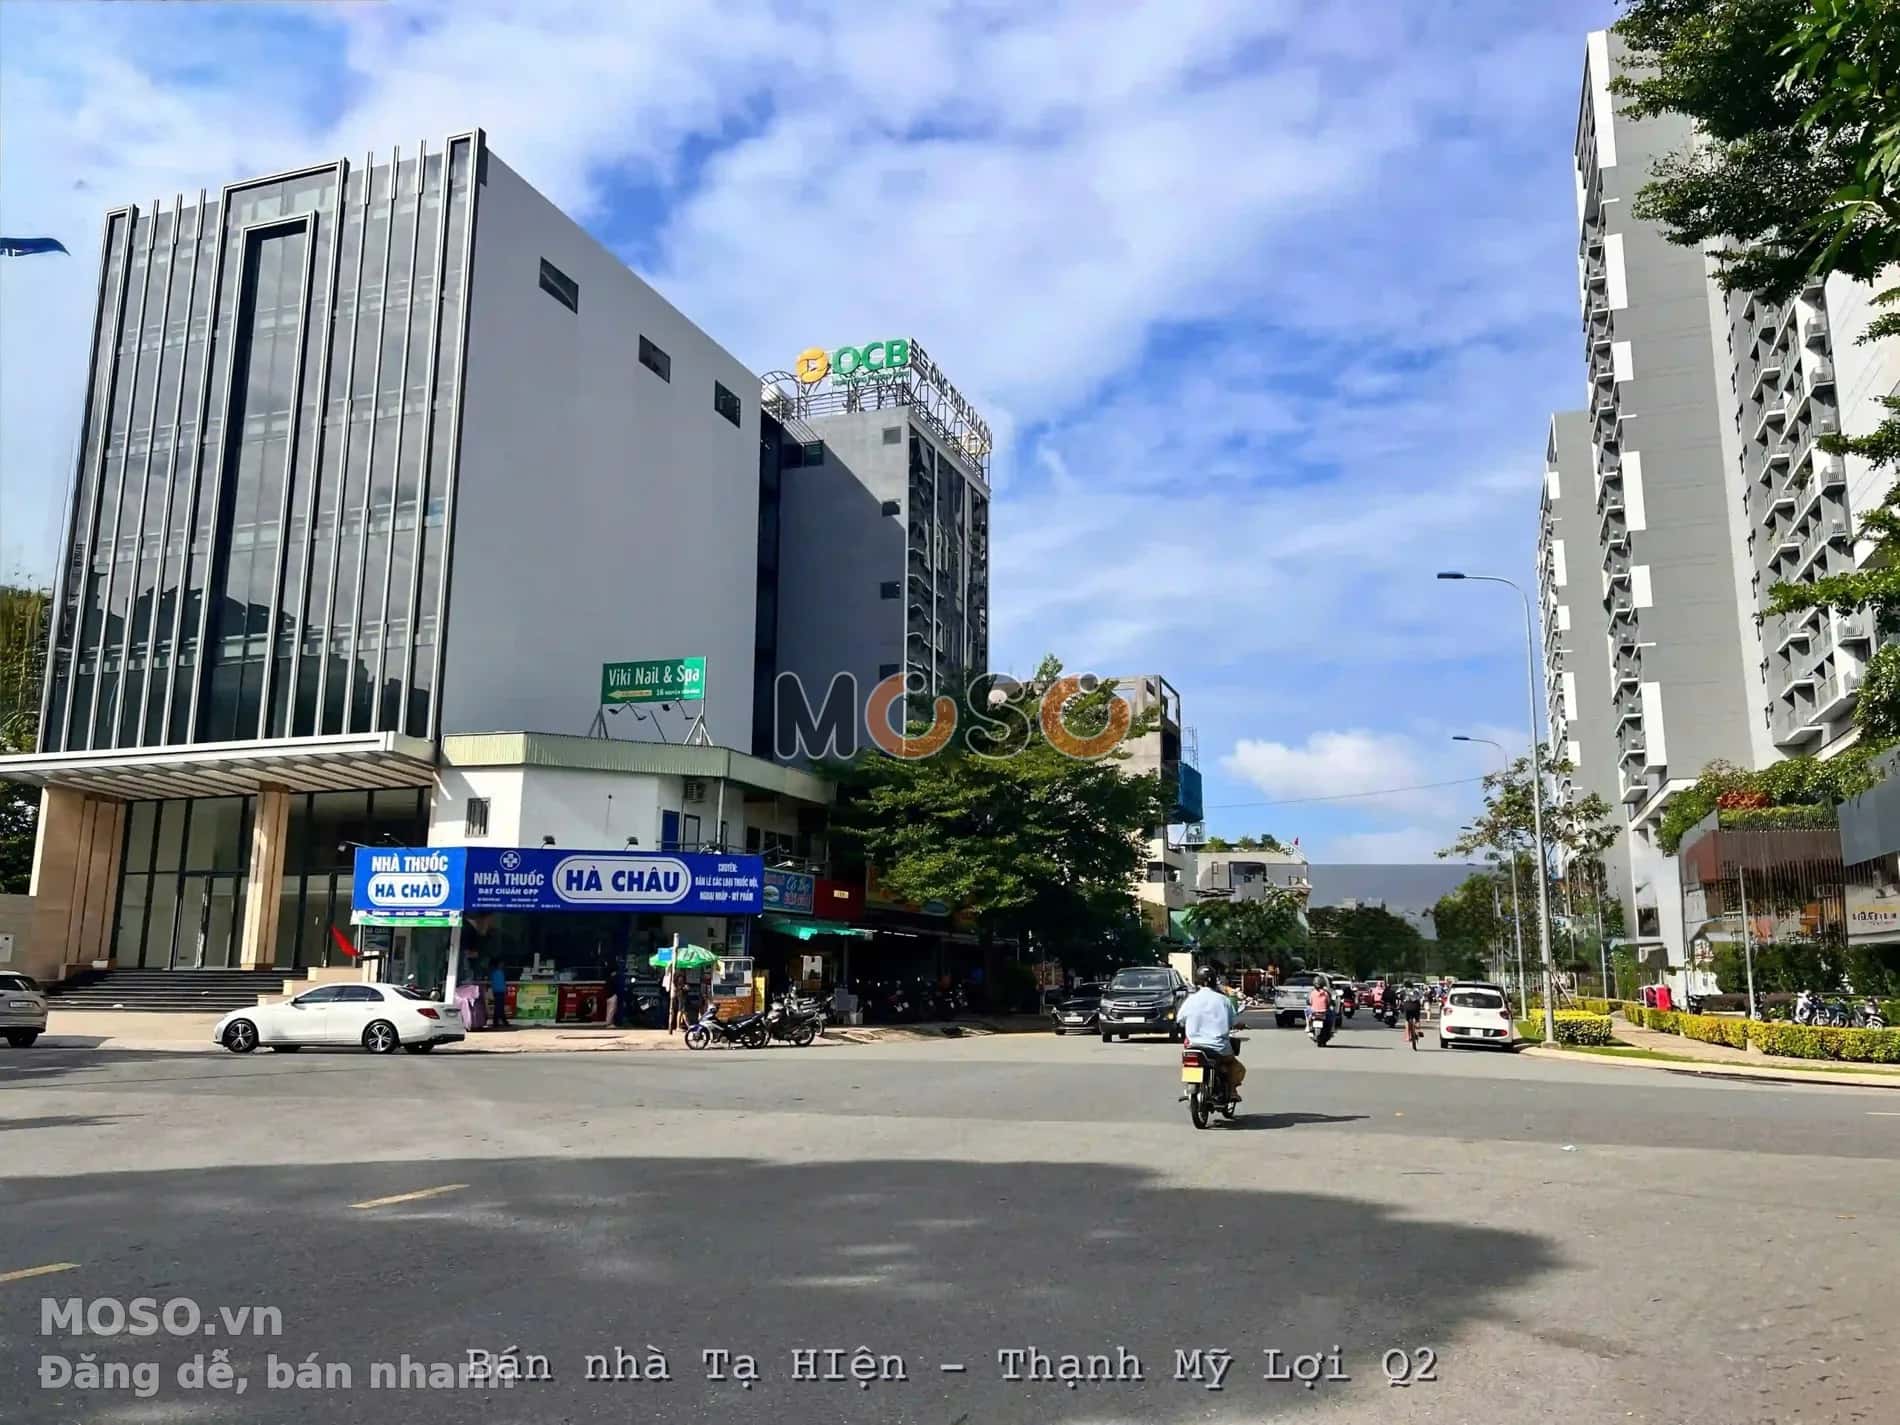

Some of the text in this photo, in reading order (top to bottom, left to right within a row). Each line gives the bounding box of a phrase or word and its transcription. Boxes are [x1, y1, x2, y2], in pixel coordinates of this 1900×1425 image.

[832, 338, 909, 374] OCB
[608, 664, 700, 687] Viki Nail & Spa
[372, 850, 448, 872] NHÀ THUỐC
[474, 869, 545, 886] NHÀ THUỐC
[565, 865, 680, 892] HÀ CHÂU
